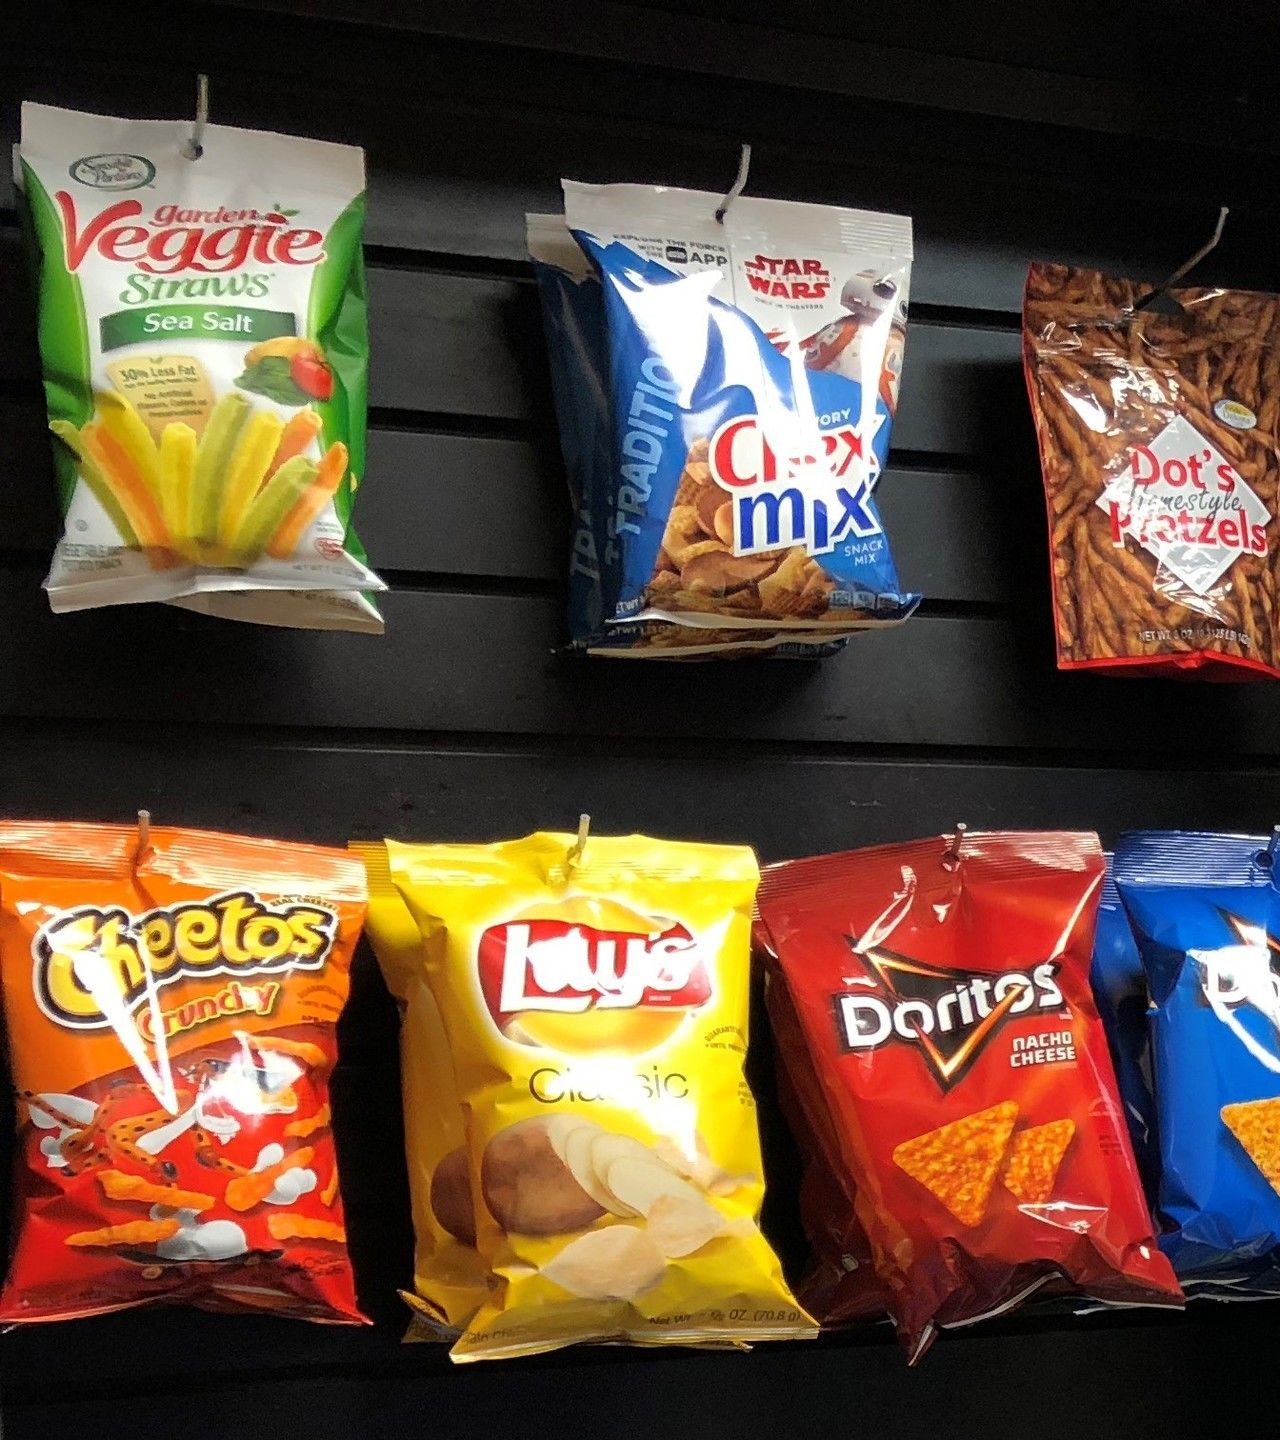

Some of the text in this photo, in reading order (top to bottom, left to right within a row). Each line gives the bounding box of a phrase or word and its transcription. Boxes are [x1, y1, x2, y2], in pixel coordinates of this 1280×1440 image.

[149, 204, 257, 227] garden
[55, 191, 327, 274] Veggie
[692, 253, 728, 266] APP
[745, 255, 829, 276] STAR
[119, 274, 271, 305] Straws
[746, 274, 830, 299] WARS
[143, 312, 252, 333] Sea Salt
[150, 365, 195, 377] Less Fat
[1130, 443, 1236, 492] Dot's
[740, 480, 875, 550] mix
[845, 539, 883, 556] SNACK
[854, 553, 876, 566] MIX
[47, 895, 332, 1016] Cheetos
[500, 924, 698, 1013] Lay's
[138, 982, 279, 1036] Crunchy
[840, 963, 1064, 1049] Doritos
[1012, 1032, 1073, 1052] NACHO
[1010, 1046, 1076, 1067] CHEESE
